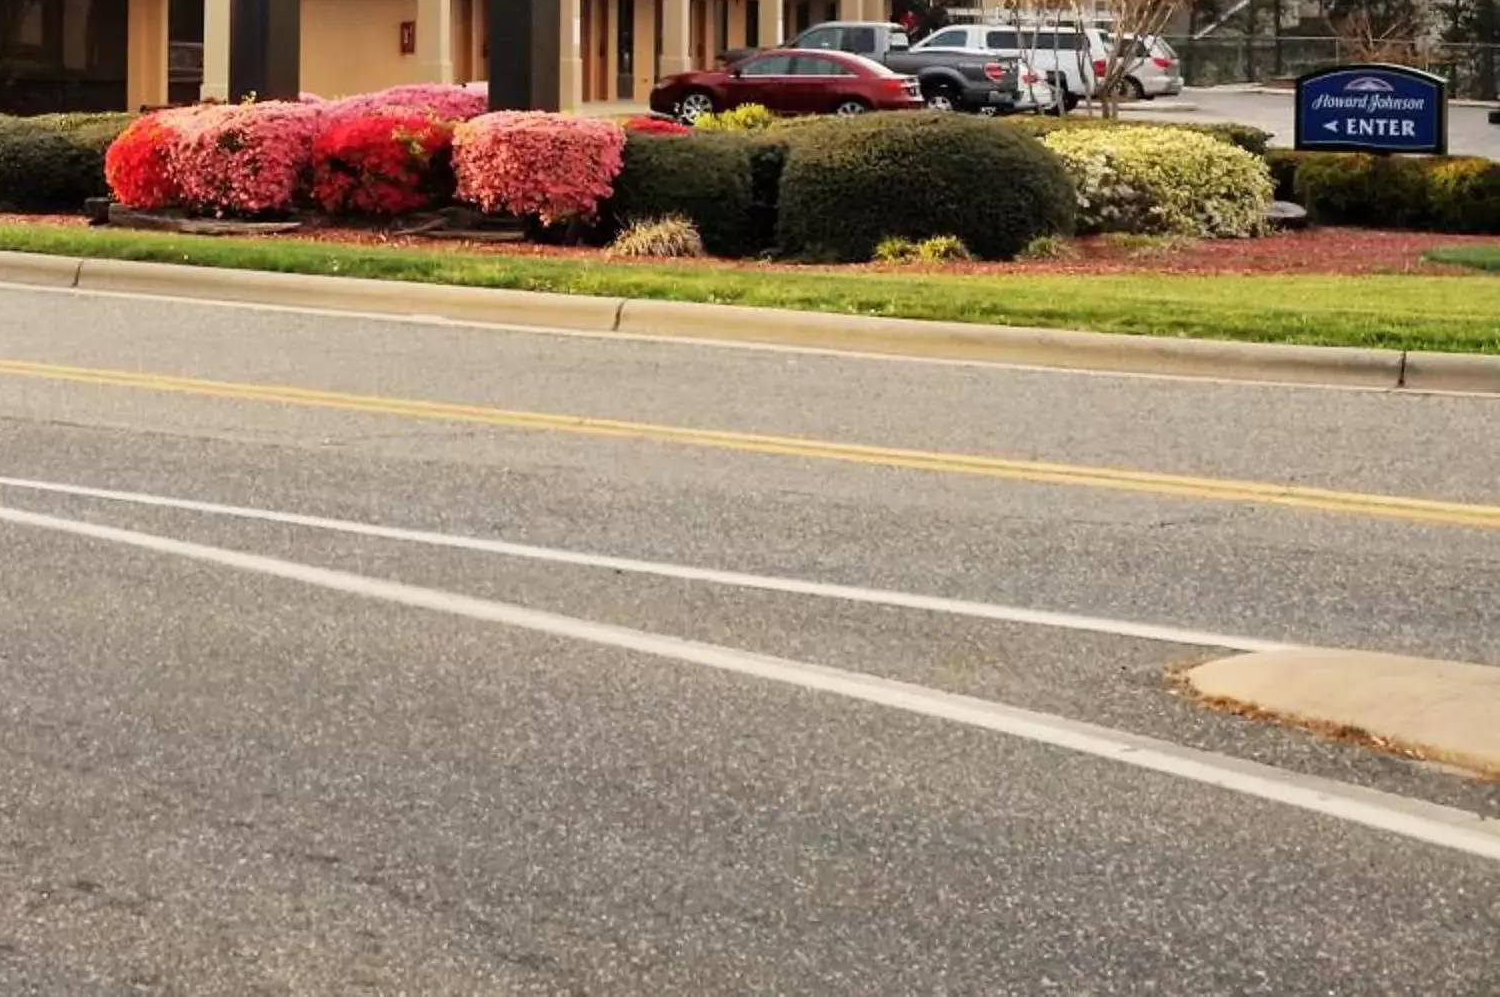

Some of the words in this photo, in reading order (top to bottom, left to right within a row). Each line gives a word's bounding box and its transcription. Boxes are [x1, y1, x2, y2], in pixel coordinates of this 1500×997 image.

[1311, 94, 1368, 111] Howard
[1365, 94, 1425, 113] Johnson
[1346, 118, 1416, 136] ENTER
